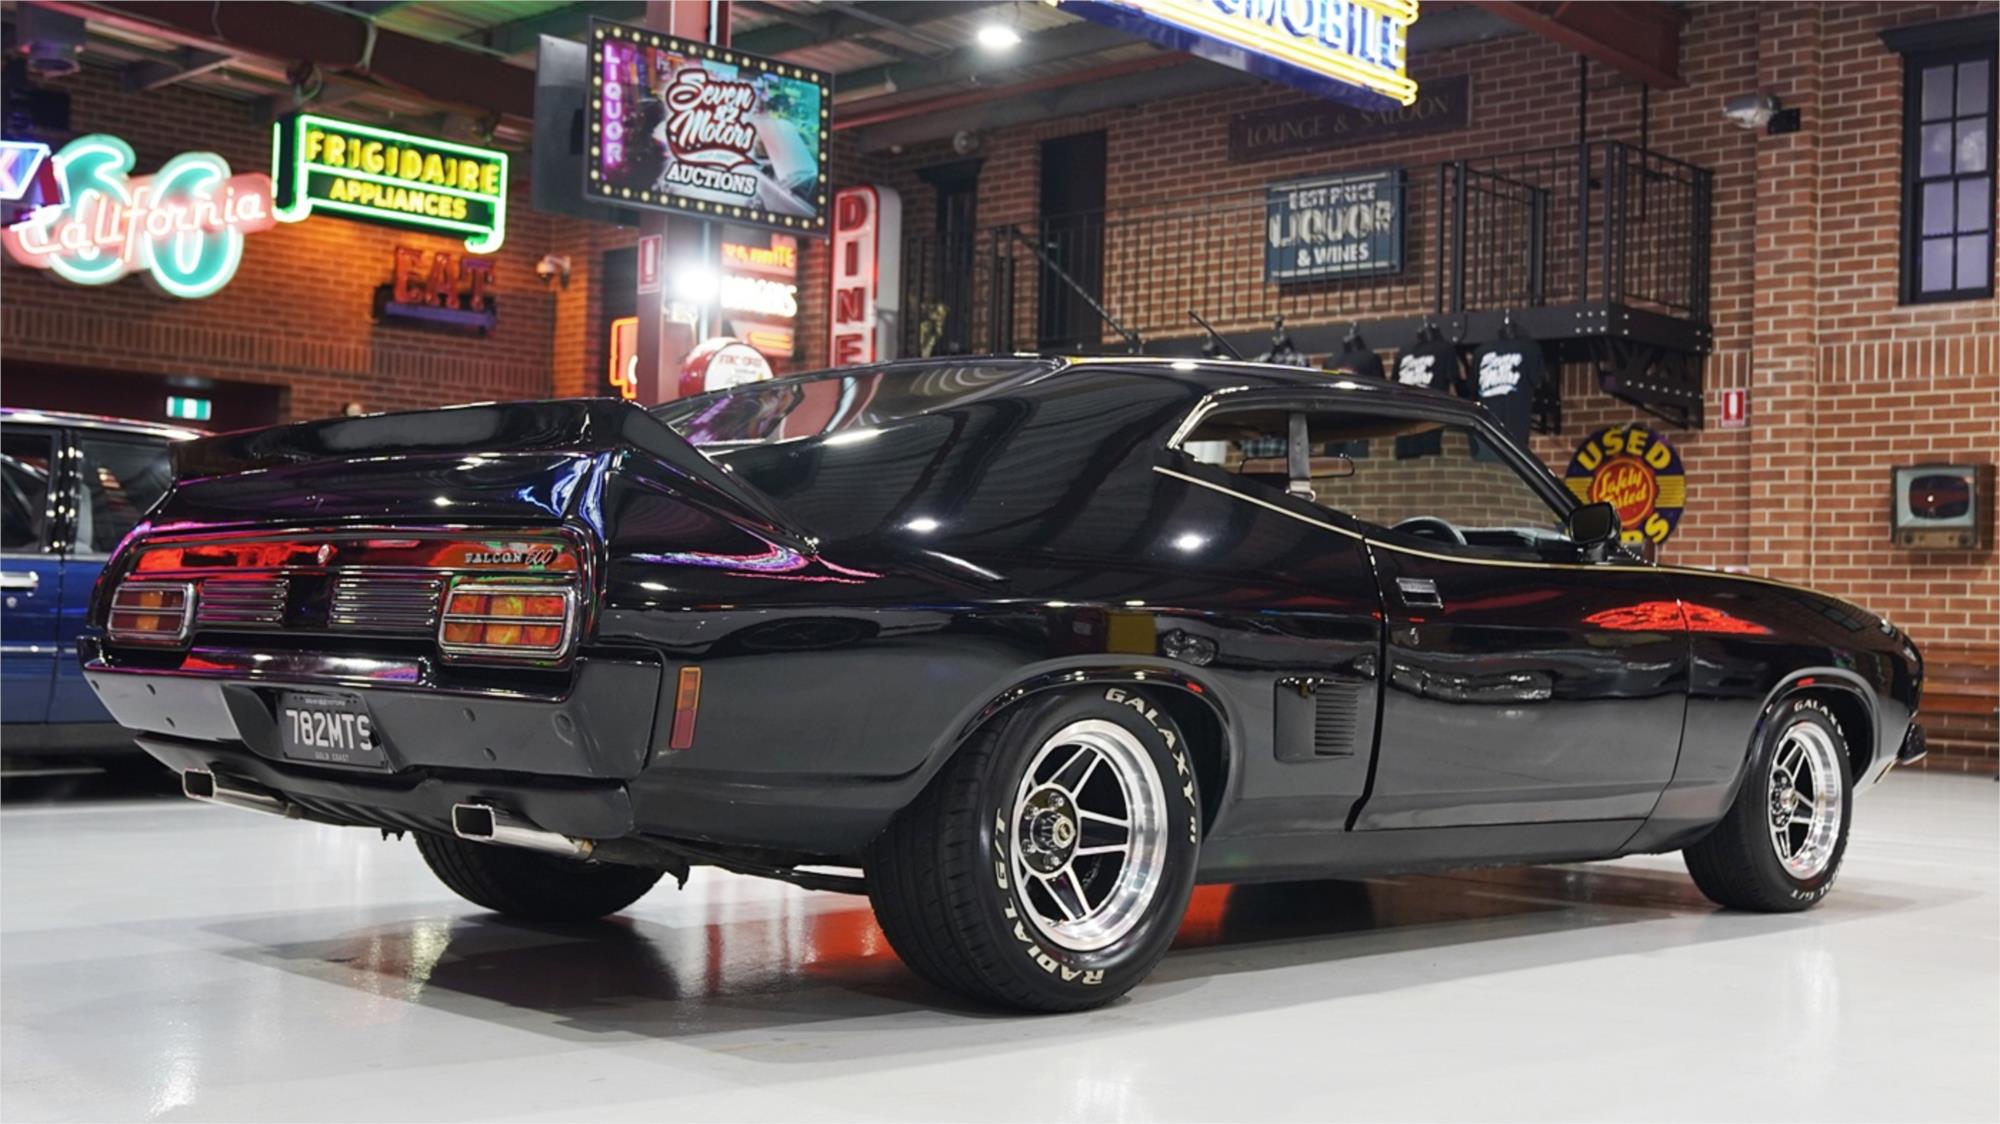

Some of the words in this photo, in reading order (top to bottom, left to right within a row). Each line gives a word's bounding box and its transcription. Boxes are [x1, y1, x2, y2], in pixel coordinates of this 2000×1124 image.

[603, 44, 624, 165] LIQUOR
[669, 70, 753, 112] Seven
[668, 109, 754, 150] Motors
[1247, 114, 1327, 148] LOUNGE
[1333, 113, 1350, 134] &
[305, 129, 500, 195] FRIGIDAIRE
[666, 162, 756, 194] AUCTIONS
[329, 178, 468, 220] APPLIANCES
[1289, 188, 1328, 210] BEST
[1330, 182, 1377, 204] PRICE
[10, 185, 267, 264] California
[1269, 200, 1392, 249] LIQUOR
[1297, 249, 1312, 267] &
[1314, 242, 1370, 265] WINES
[394, 245, 495, 311] EAT
[1577, 428, 1671, 471] USED
[464, 552, 522, 564] FALCON
[285, 708, 374, 752] 782MTS
[1793, 699, 1845, 738] GALAXY
[1105, 687, 1196, 807] GALAXY
[994, 807, 1009, 890] G/T
[1004, 896, 1105, 985] RADIAL
